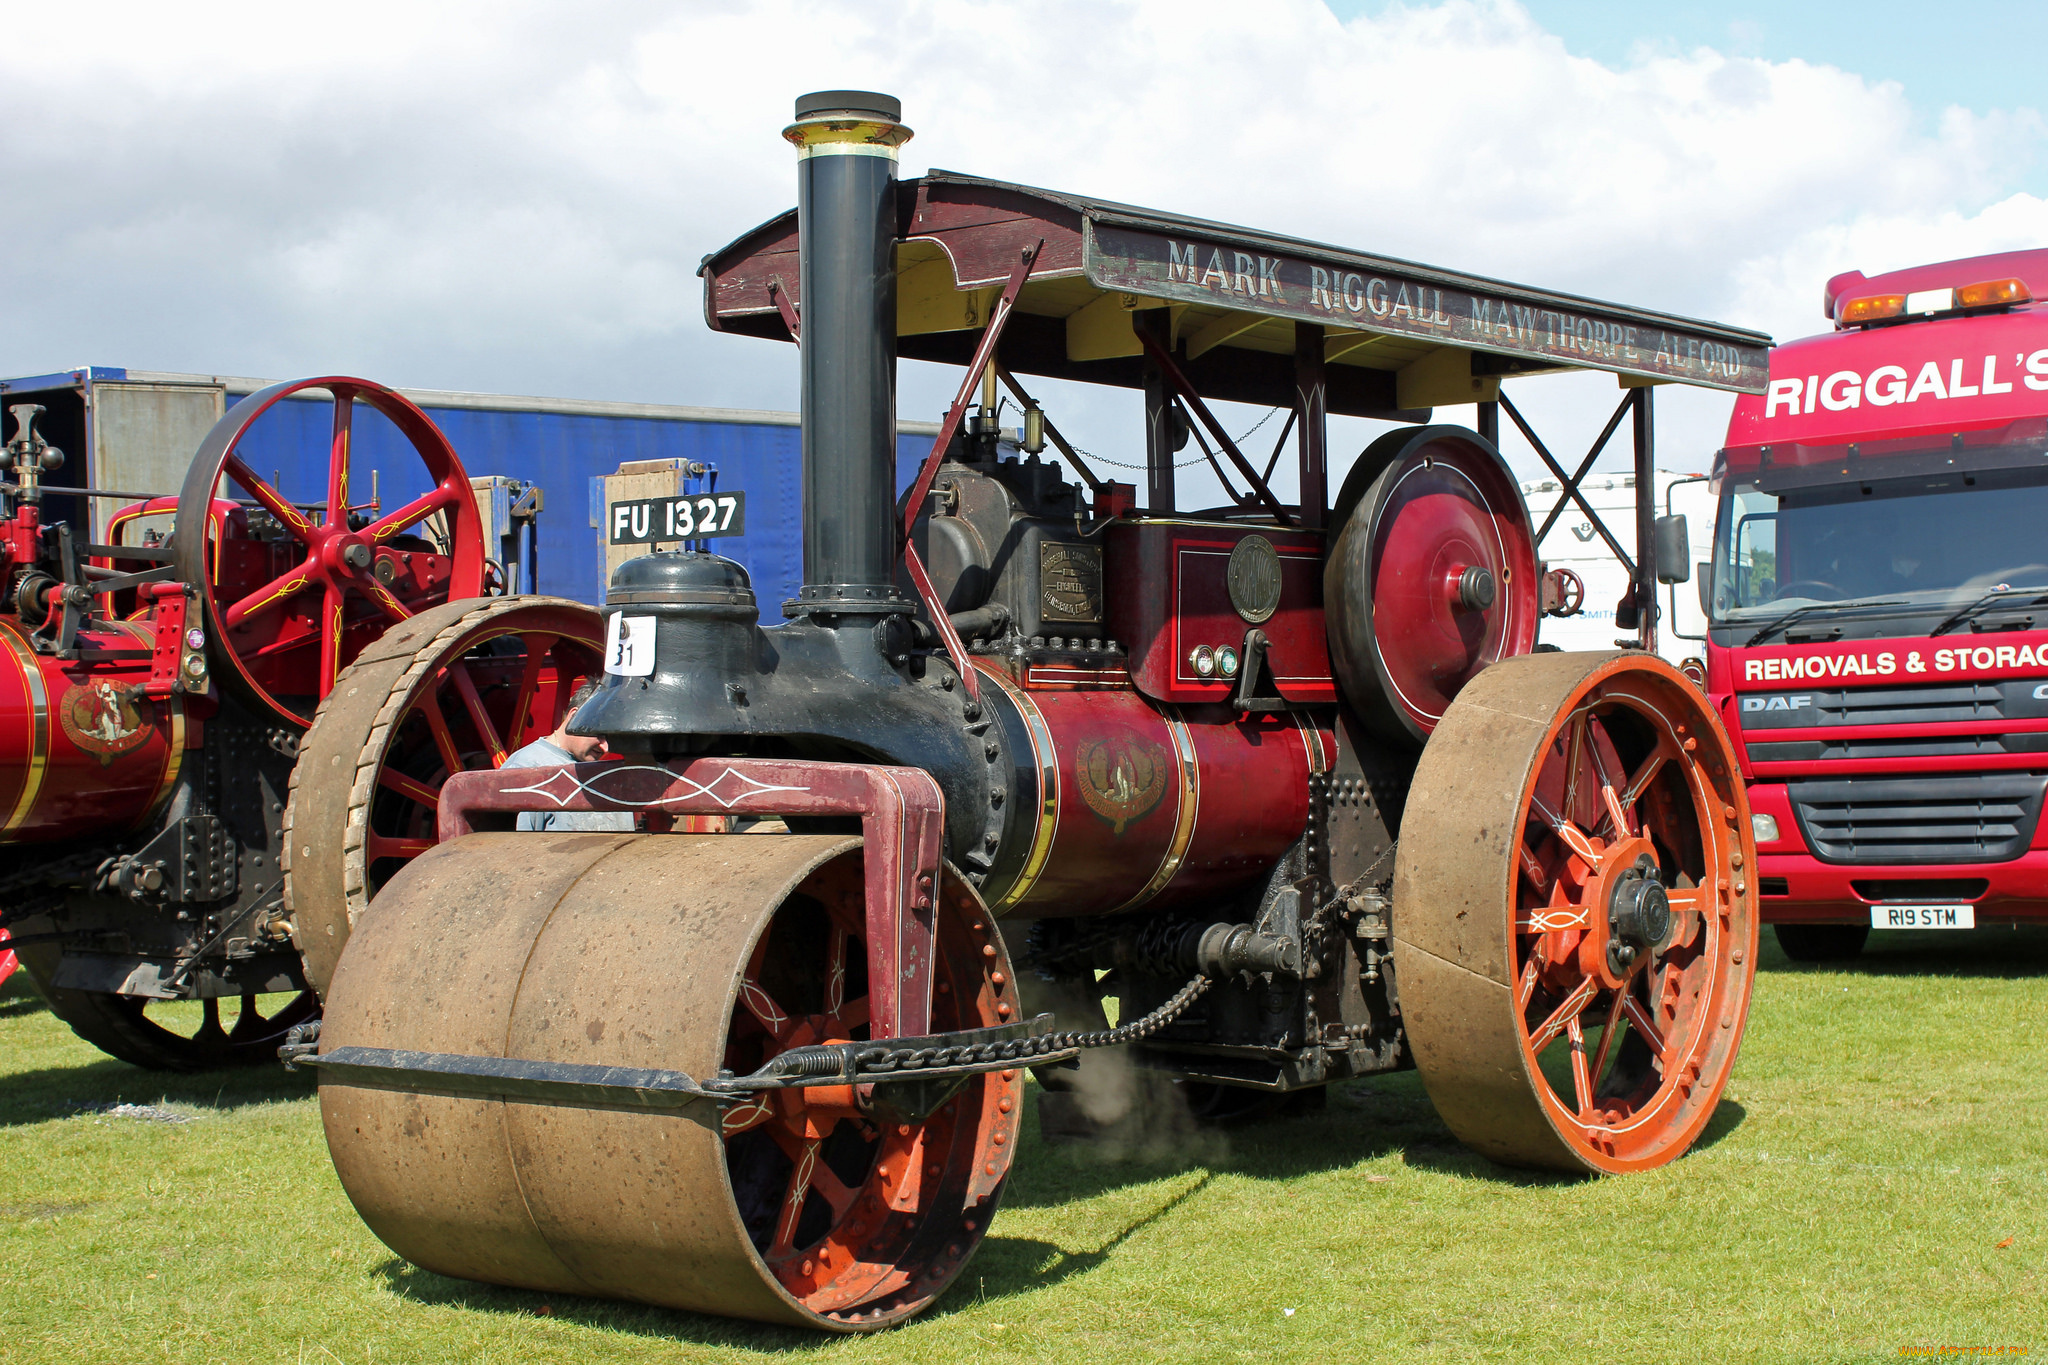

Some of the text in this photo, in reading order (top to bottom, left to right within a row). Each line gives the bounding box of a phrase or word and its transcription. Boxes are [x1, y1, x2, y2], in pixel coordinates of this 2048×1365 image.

[1167, 240, 1742, 378] MARK RIGGALL MAWTHORPE ALFORD
[1765, 348, 2048, 418] RIGGALL'S
[614, 497, 738, 539] FU 1327
[1745, 651, 1897, 681] REMOVALS
[1905, 651, 1927, 674] &
[1743, 695, 1812, 712] DAF
[1888, 909, 1956, 926] R19 STM
